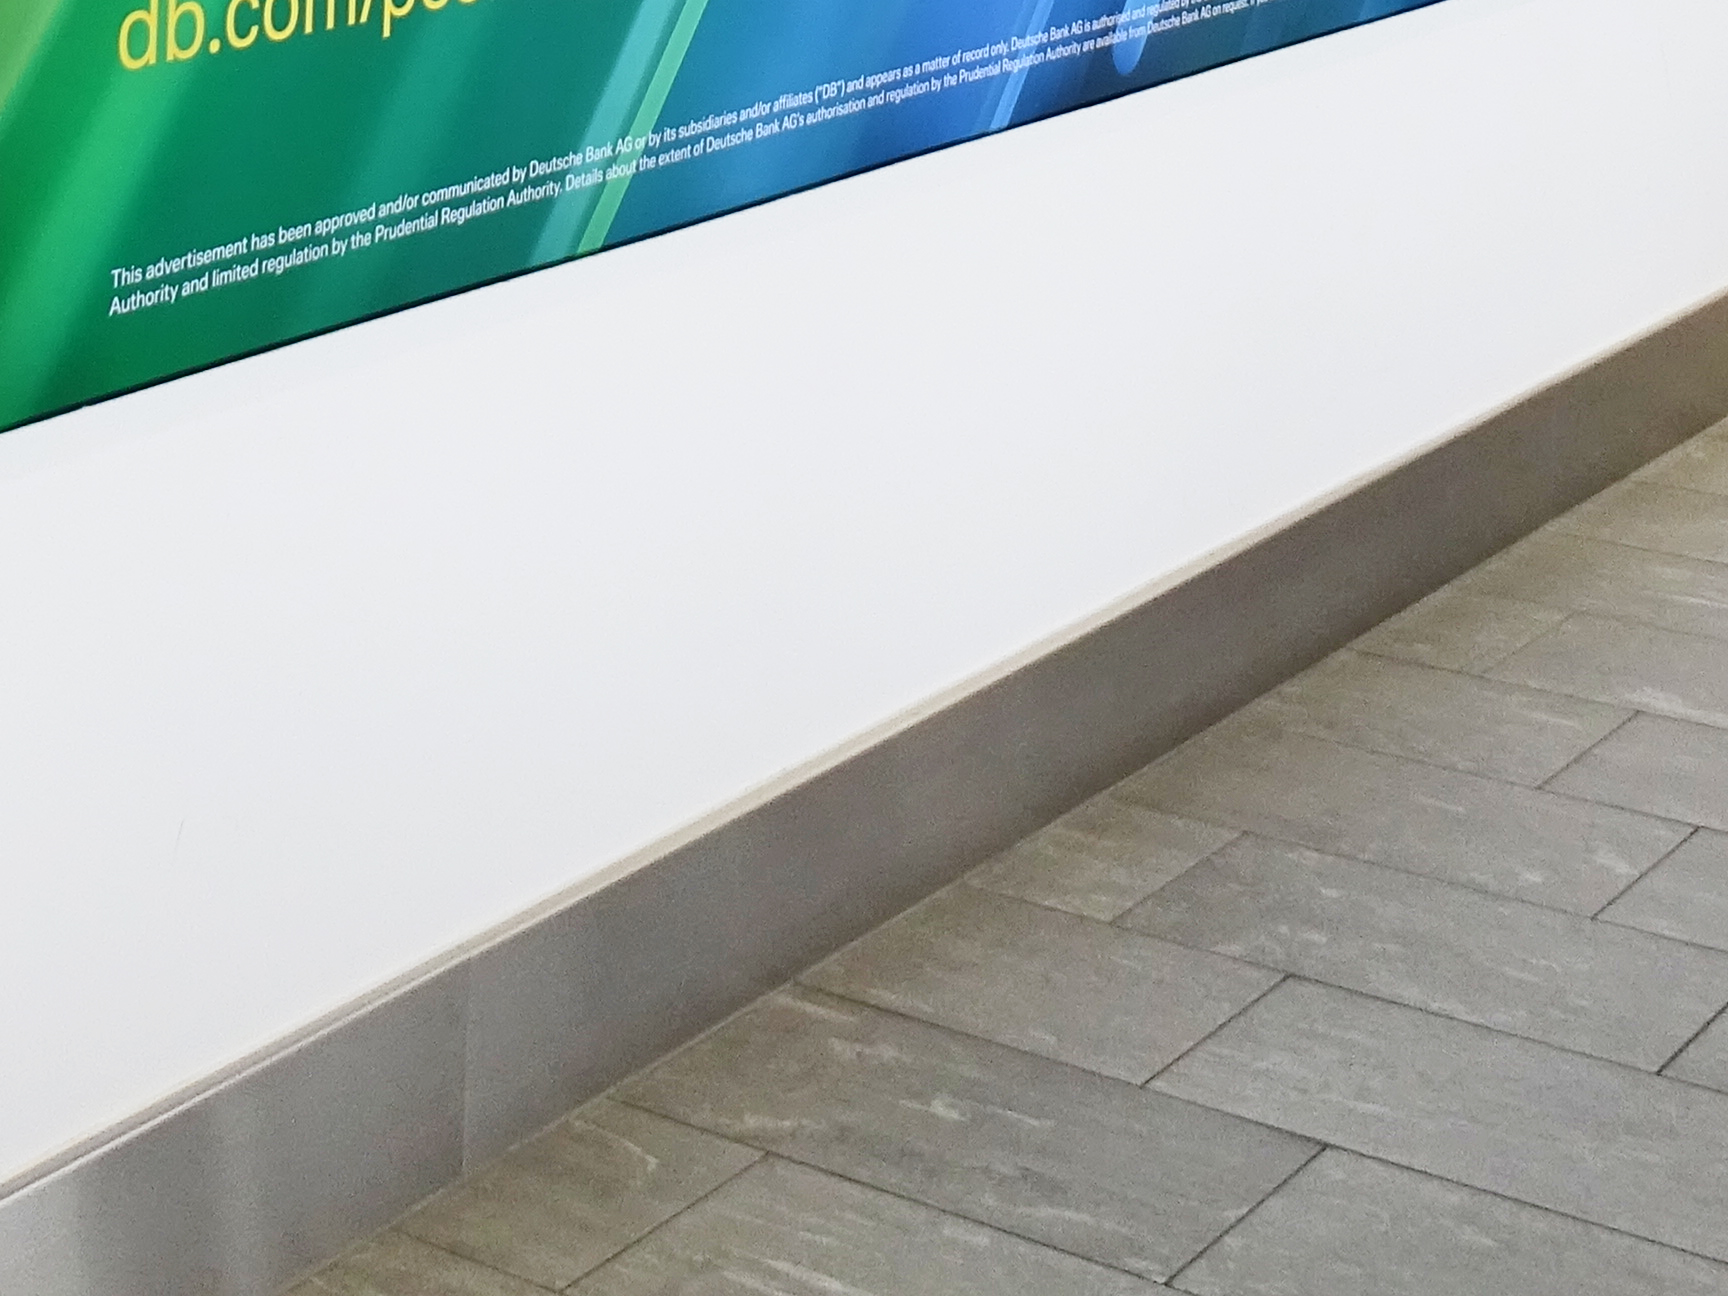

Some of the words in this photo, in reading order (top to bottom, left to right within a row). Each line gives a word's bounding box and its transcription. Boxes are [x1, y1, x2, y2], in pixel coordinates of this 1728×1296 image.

[108, 282, 178, 317] Authority
[181, 271, 208, 297] and
[211, 258, 259, 289] limited
[261, 244, 328, 276] regulation
[331, 236, 347, 258] by
[350, 230, 371, 251] the
[374, 210, 438, 245] Prudential
[440, 197, 504, 227] Regulation
[506, 179, 563, 209] Authority.
[565, 168, 603, 193] Details
[605, 157, 637, 182] about
[638, 154, 656, 173] the
[658, 143, 691, 167] extent
[693, 139, 704, 158] of
[705, 128, 753, 154] Deutsche
[755, 119, 780, 141] Bank
[805, 99, 865, 127] authorisation
[867, 91, 884, 111] and
[886, 82, 929, 106] regulation
[930, 77, 942, 95] by
[943, 73, 957, 90] the
[958, 60, 1001, 86] Prudential
[1002, 51, 1044, 74] Regulation
[110, 264, 143, 290] This
[145, 235, 248, 281] advertisement
[250, 232, 275, 253] has
[278, 223, 312, 245] been
[314, 202, 376, 238] approved
[378, 194, 418, 219] and/or
[421, 167, 510, 208] communicated
[511, 165, 527, 185] by
[529, 150, 582, 179] Deutsche
[585, 141, 613, 164] Bank
[614, 136, 632, 157] AG
[634, 136, 647, 151] or
[648, 130, 662, 150] by
[663, 126, 676, 144] its
[678, 111, 737, 140] subsidiaries
[739, 102, 771, 124] and/or
[772, 92, 813, 115] affiliates
[846, 76, 864, 95] and
[865, 70, 901, 92] appears
[902, 67, 913, 81] as
[914, 65, 920, 77] a
[921, 56, 950, 75] matter
[951, 51, 961, 68] of
[961, 43, 989, 65] record
[990, 40, 1009, 57] only.
[1010, 29, 1048, 52] Deutsche
[1049, 23, 1069, 42] Bank
